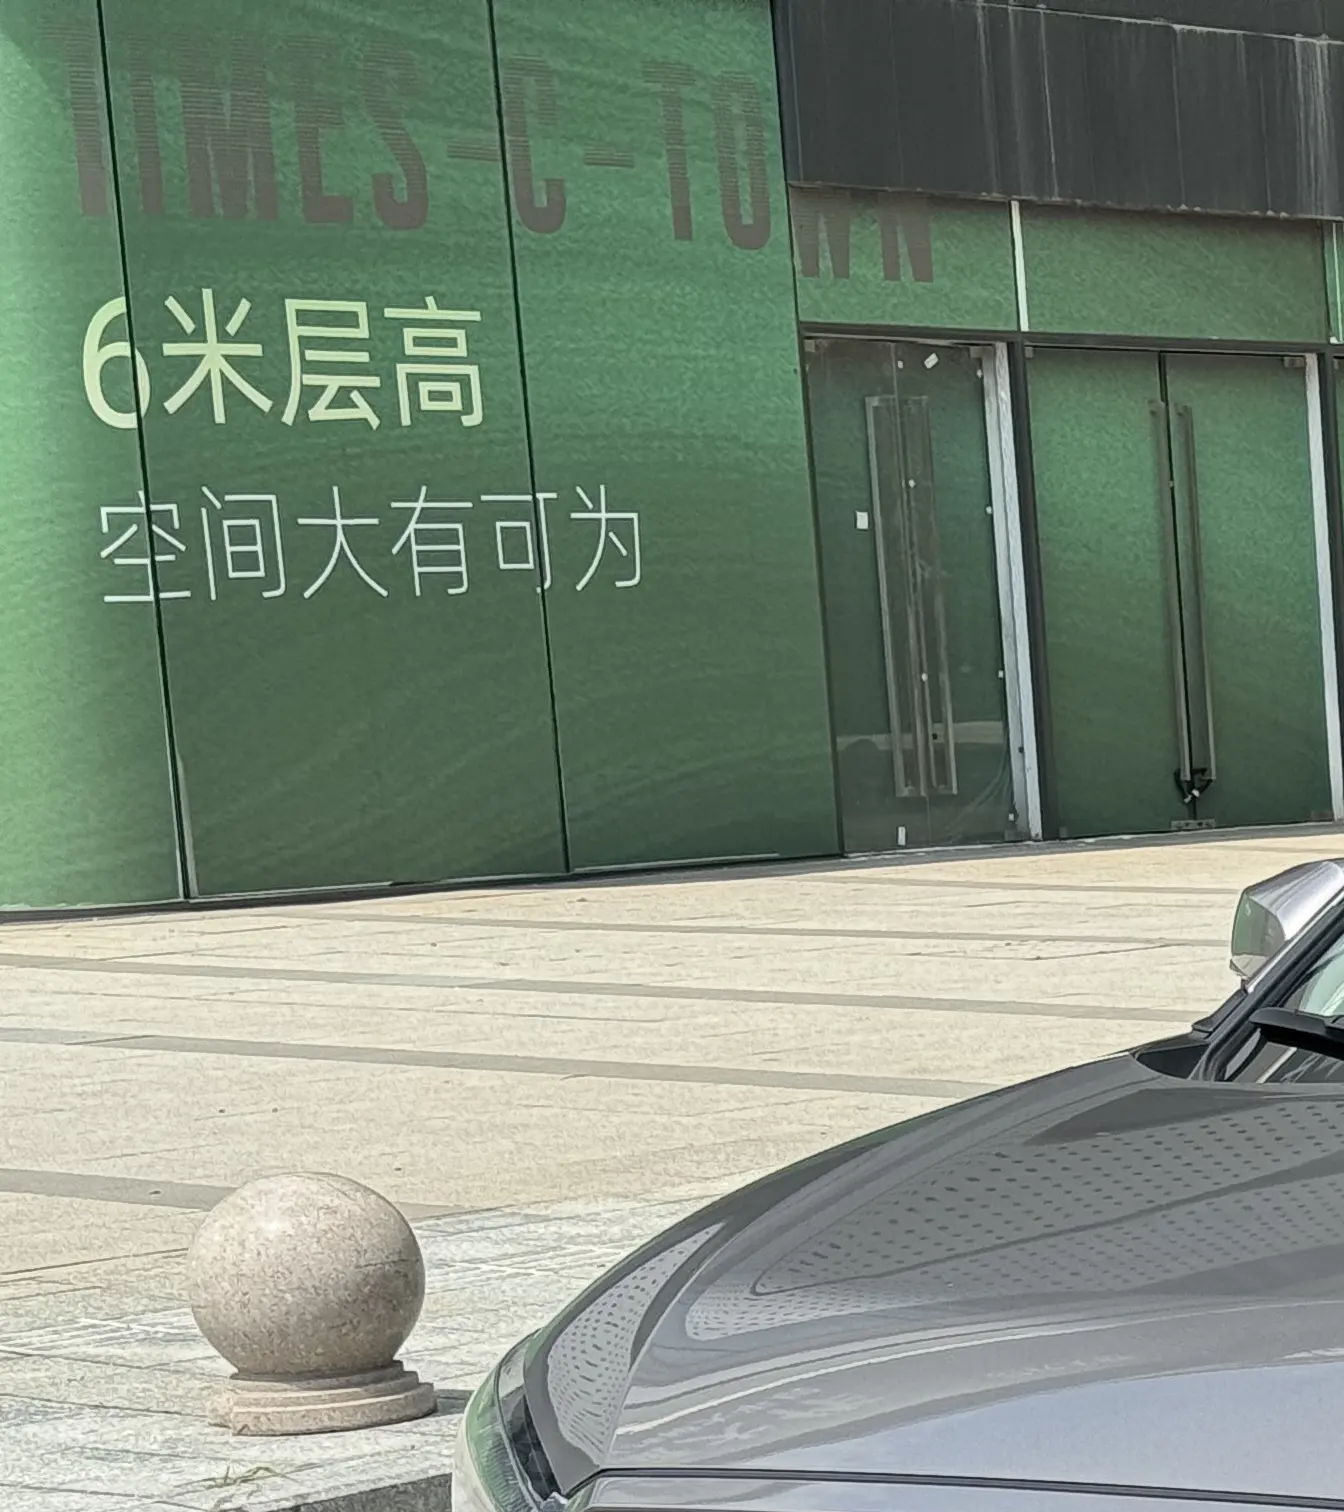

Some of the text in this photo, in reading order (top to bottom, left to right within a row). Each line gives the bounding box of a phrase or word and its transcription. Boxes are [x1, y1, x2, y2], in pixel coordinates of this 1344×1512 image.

[82, 287, 484, 431] 6米层高
[99, 485, 642, 602] 空间大有可为
